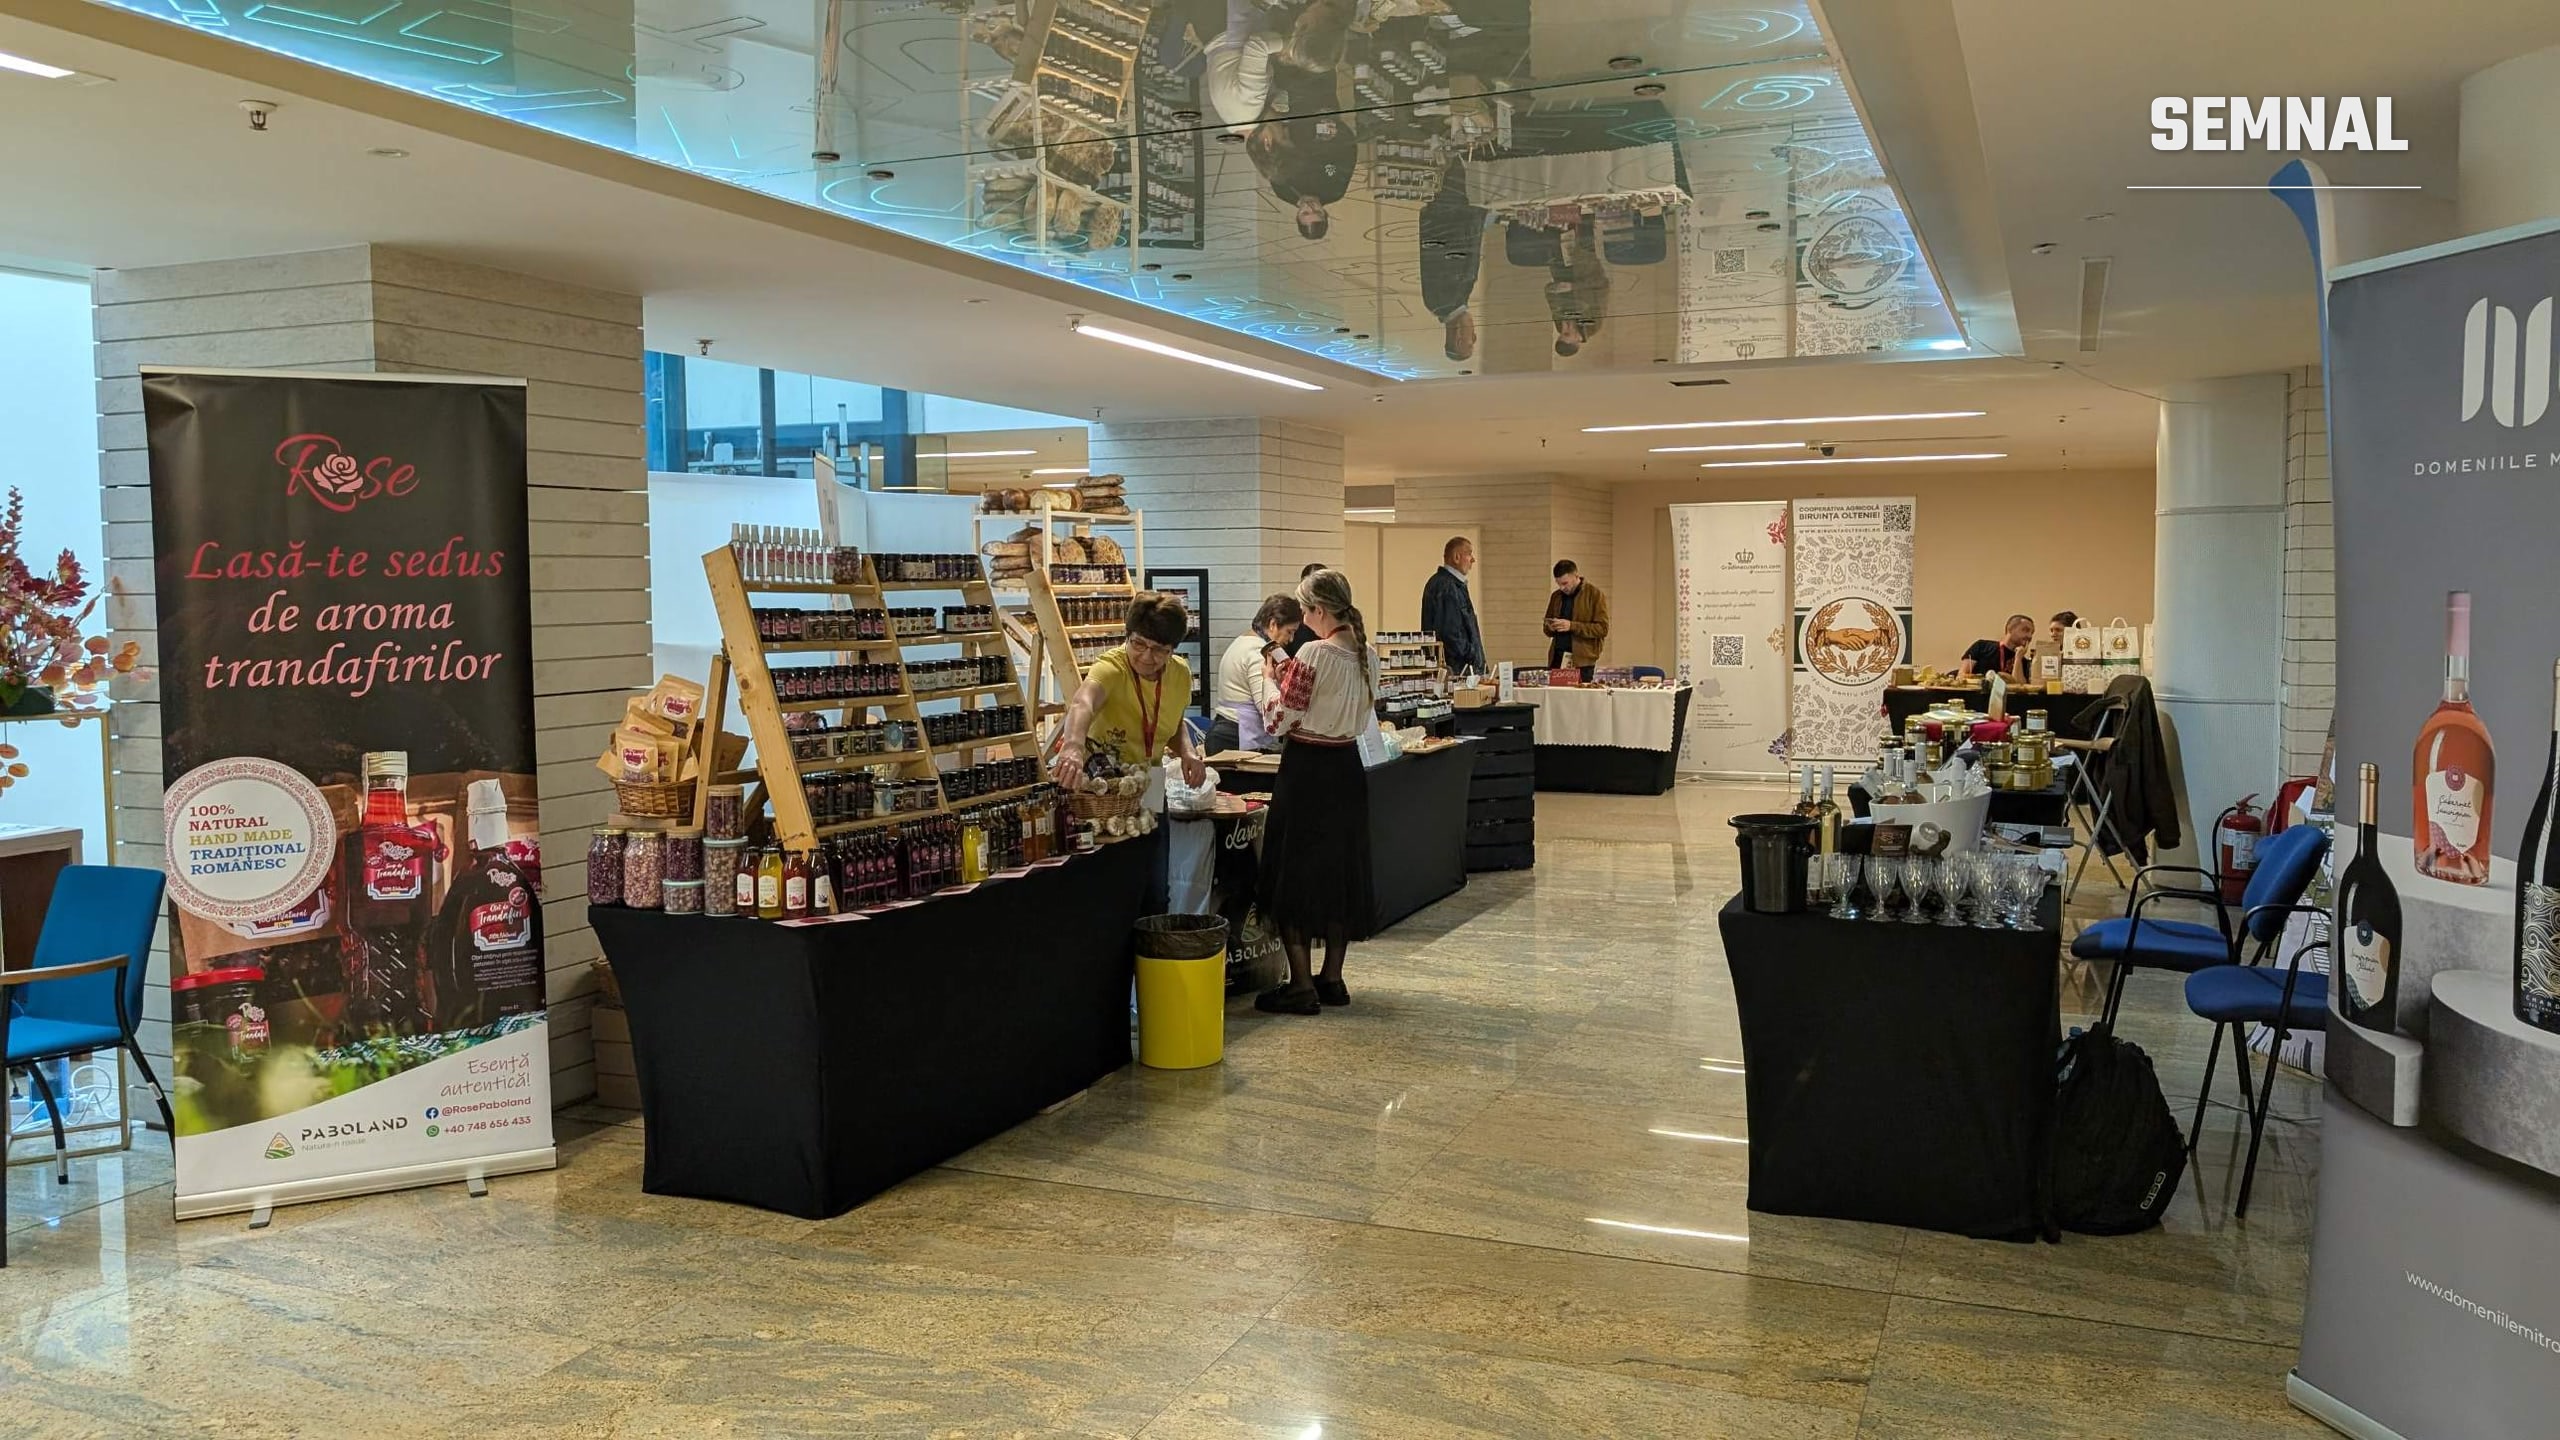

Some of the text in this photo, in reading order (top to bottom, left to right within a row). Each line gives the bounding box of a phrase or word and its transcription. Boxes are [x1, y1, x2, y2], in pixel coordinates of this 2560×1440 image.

[2414, 453, 2537, 476] DOMENIILE
[1799, 511, 1880, 521] BIRUINȚA OLTENIEI
[185, 535, 505, 579] Lasă-te sedus
[247, 590, 455, 633] de aroma
[204, 640, 502, 697] trandafirilor
[189, 804, 235, 817] 100%
[189, 816, 269, 832] NATURAL
[189, 829, 293, 846] HAND MADE
[190, 842, 306, 861] TRADIȚIONAL
[190, 858, 287, 875] ROMÂNESC
[1226, 937, 1282, 965] ABOLAND
[468, 1052, 530, 1074] Esență
[440, 1072, 531, 1097] autentică!
[441, 1096, 532, 1117] @RosePaboland
[301, 1116, 408, 1141] PABOLAND
[444, 1115, 532, 1134] +40 748 656 433
[2405, 1269, 2560, 1354] www.domeniilemitro
